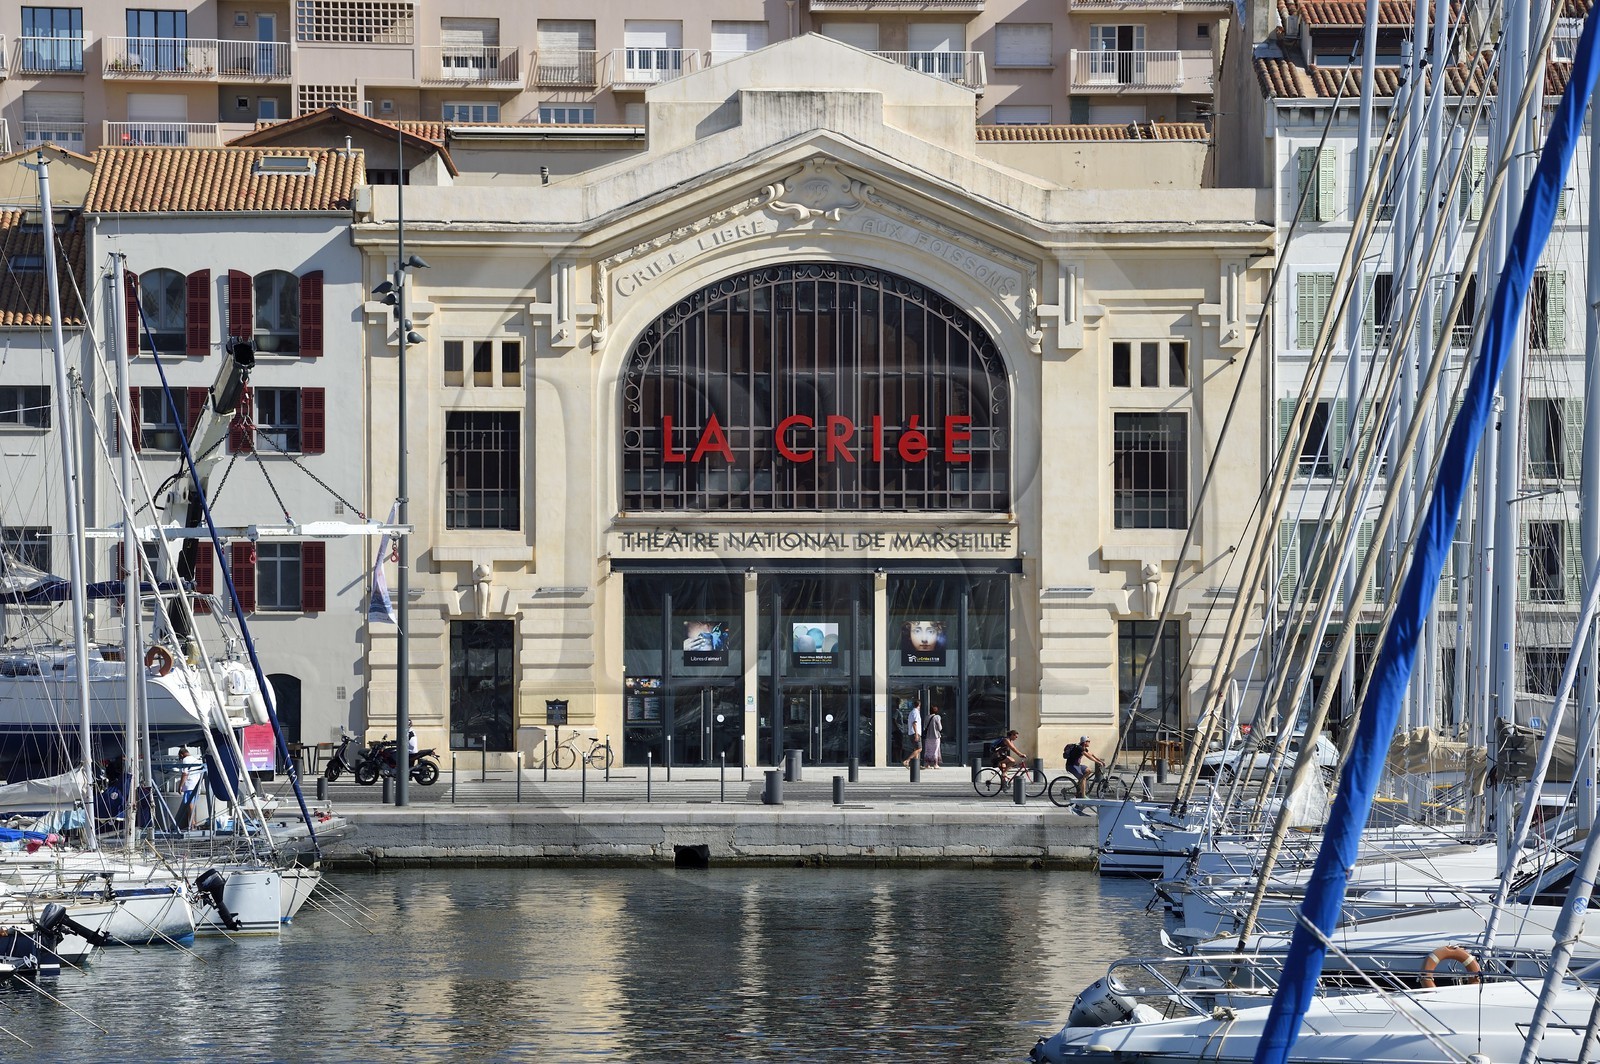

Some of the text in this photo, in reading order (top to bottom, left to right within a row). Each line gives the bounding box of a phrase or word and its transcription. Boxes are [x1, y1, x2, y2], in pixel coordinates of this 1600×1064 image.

[697, 220, 766, 250] LIBRE
[861, 219, 903, 240] AUX
[663, 413, 735, 463] LA
[622, 527, 1012, 549] THÉÂTRE NATIONAL DE MARSEILLE
